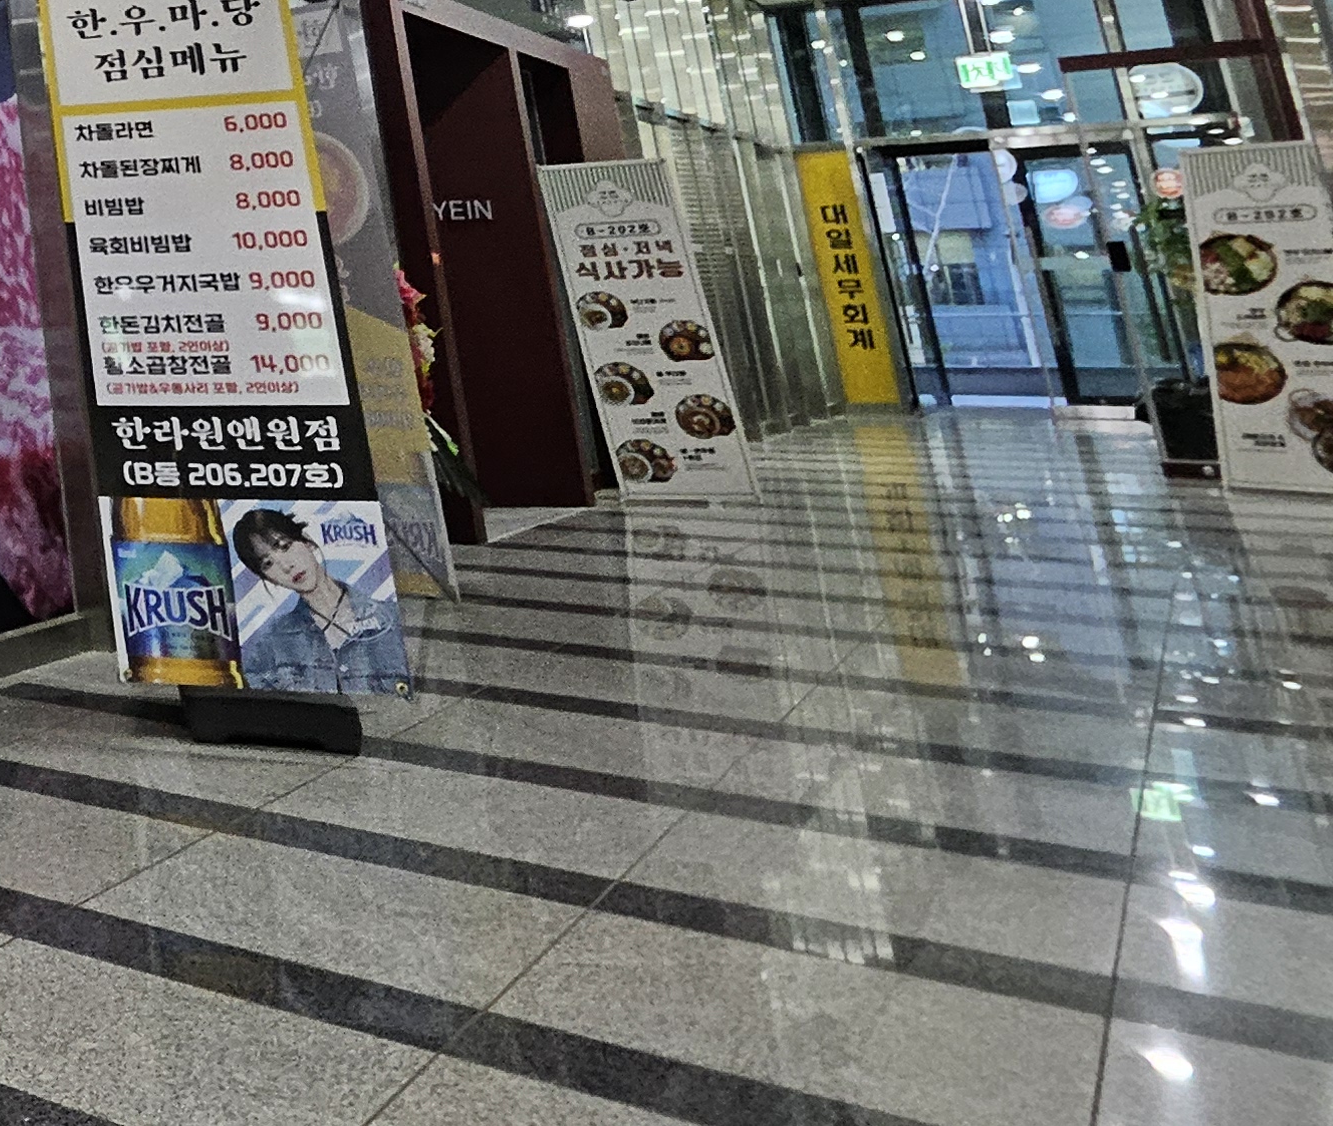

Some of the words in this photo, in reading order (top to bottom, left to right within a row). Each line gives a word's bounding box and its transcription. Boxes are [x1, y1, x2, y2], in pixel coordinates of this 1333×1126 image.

[94, 42, 247, 83] 점심메뉴
[74, 120, 155, 141] 차돌라면
[224, 111, 288, 134] 6,000
[229, 150, 294, 172] 8,000
[84, 197, 145, 216] 비빔밥
[235, 189, 301, 212] 8,000
[432, 200, 493, 220] YEIN
[89, 233, 192, 255] 육회비빔밥
[233, 230, 309, 251] 10,000
[249, 270, 316, 292] 9,000
[575, 258, 683, 281] 식사가능
[819, 205, 875, 350] 대일세무회계
[99, 313, 226, 335] 한돈김치전골
[256, 311, 323, 333] 9,000
[249, 354, 330, 376] 14,000
[111, 416, 342, 453] 한라원앤원점
[122, 461, 181, 486] (B동
[320, 523, 377, 546] KRUSH
[122, 584, 232, 641] KRUSH
